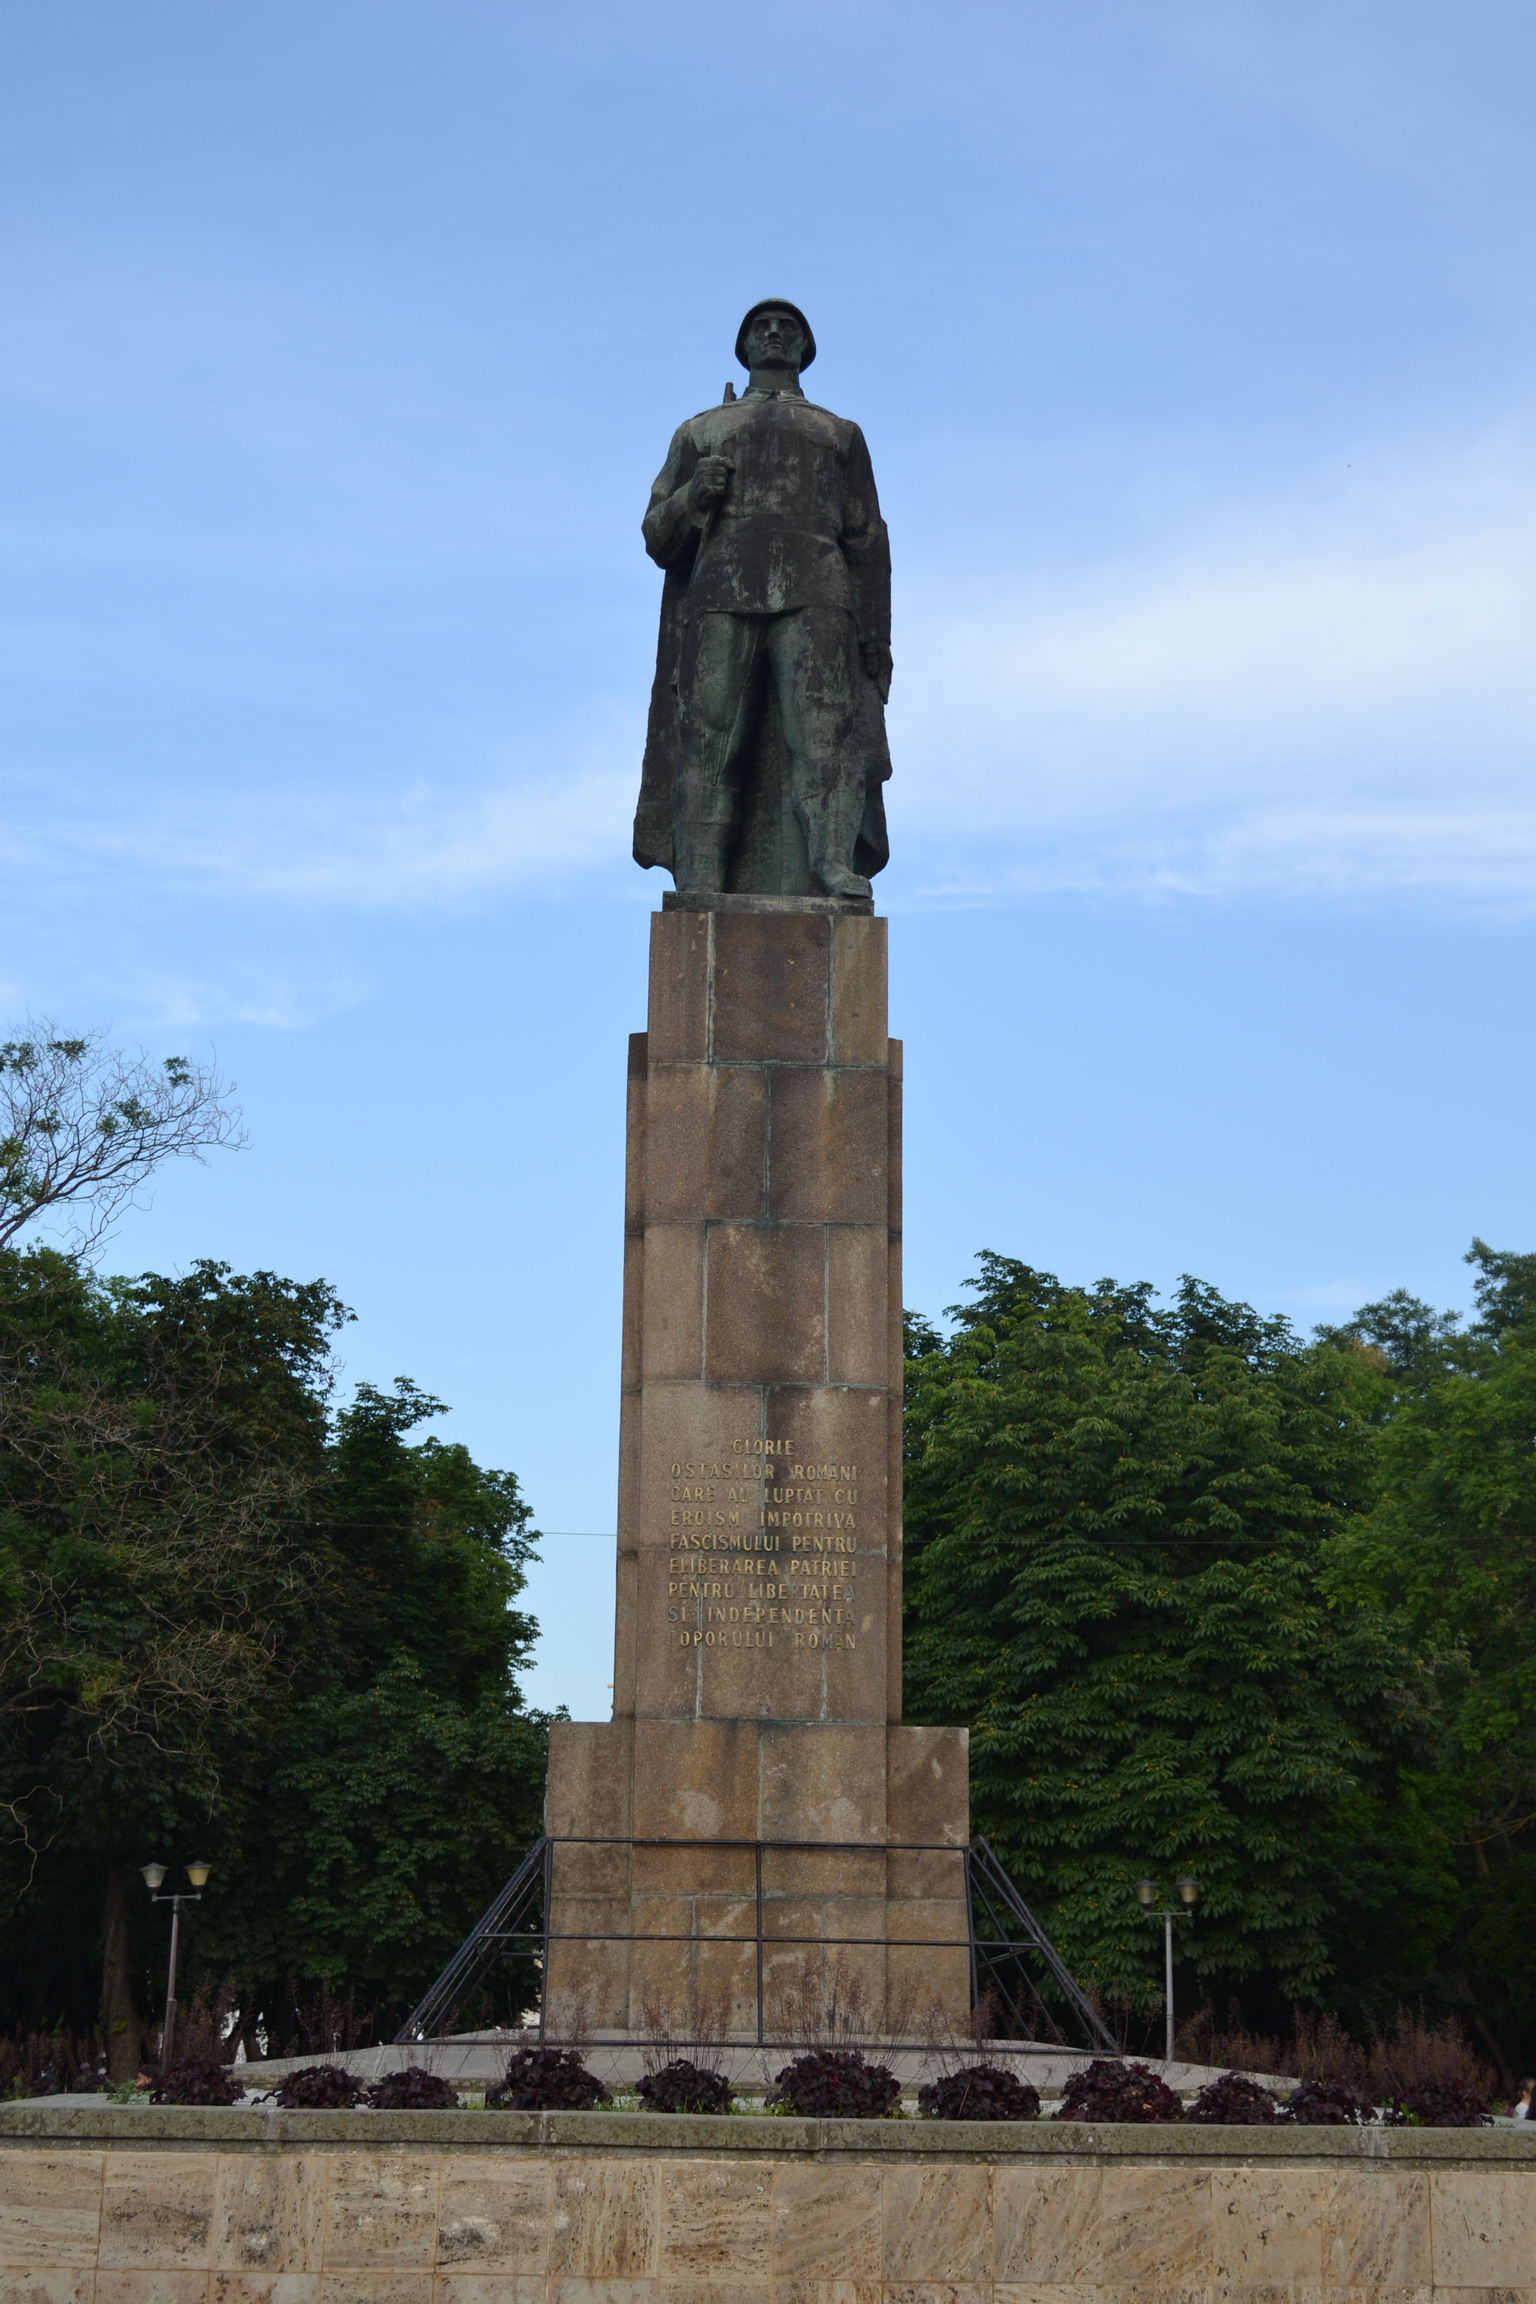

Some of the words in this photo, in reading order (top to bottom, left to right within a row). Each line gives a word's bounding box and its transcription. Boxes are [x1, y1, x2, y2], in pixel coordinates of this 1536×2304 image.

[733, 1439, 794, 1456] GLORIE
[671, 1463, 774, 1480] OSTASILOR
[671, 1486, 715, 1502] CARE
[727, 1487, 749, 1503] AU
[764, 1488, 823, 1505] LUPTAT
[835, 1489, 857, 1506] CU
[671, 1510, 740, 1527] EROISM
[760, 1511, 856, 1529] IMPOTRIVA
[670, 1534, 780, 1552] FASCISMULUI
[792, 1536, 857, 1554] PENTRU
[669, 1558, 779, 1576] ELIBERAREA
[790, 1559, 857, 1577] PATRIEI
[668, 1582, 735, 1599] PENTRU
[749, 1584, 855, 1601] LIBERTATEA
[668, 1606, 686, 1623] SI
[708, 1607, 856, 1625] INDEPENDENTA
[669, 1629, 774, 1648] POPORULUI
